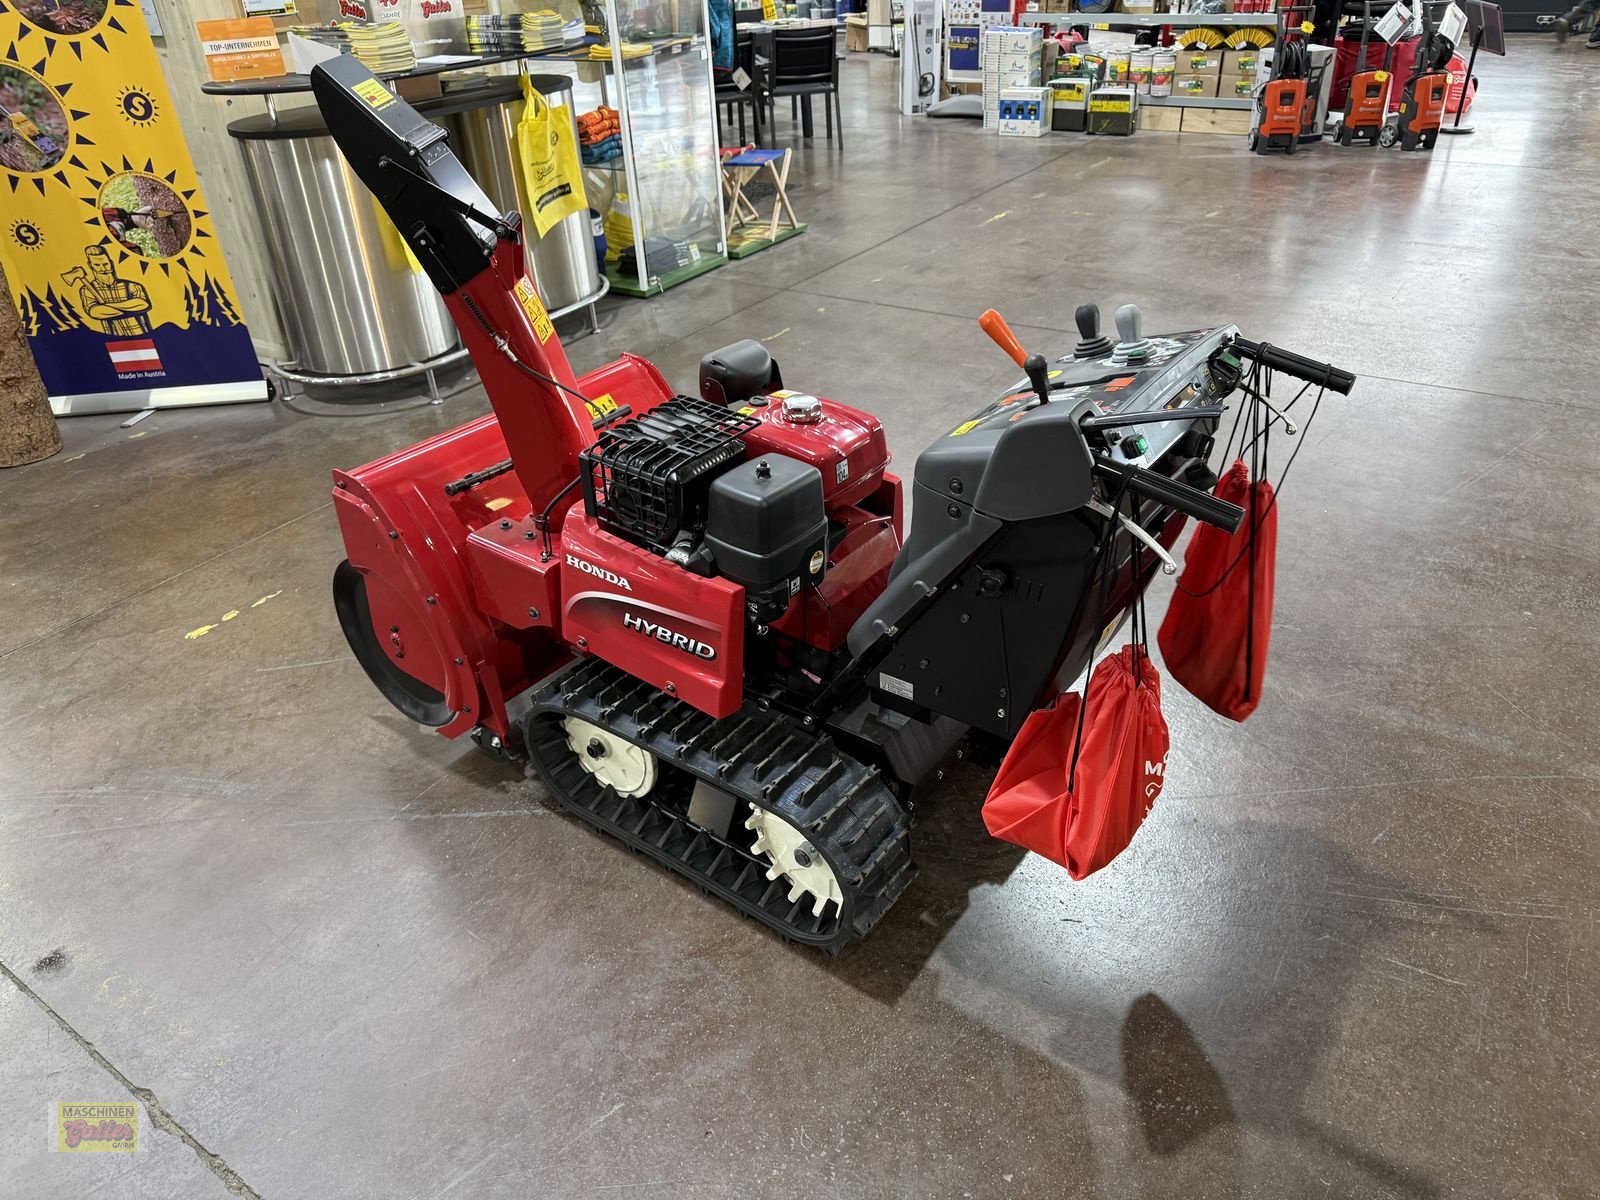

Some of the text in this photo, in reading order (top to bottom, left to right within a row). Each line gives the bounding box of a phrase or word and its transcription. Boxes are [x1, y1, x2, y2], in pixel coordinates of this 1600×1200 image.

[382, 11, 401, 19] JAHRE
[209, 41, 272, 52] TOP-UNTERNEHMEN
[130, 96, 145, 117] S
[20, 226, 35, 243] S
[118, 372, 137, 380] Made
[144, 370, 166, 378] Austria
[566, 553, 632, 591] HONDA
[623, 612, 717, 660] HYBRID
[1145, 760, 1165, 776] M
